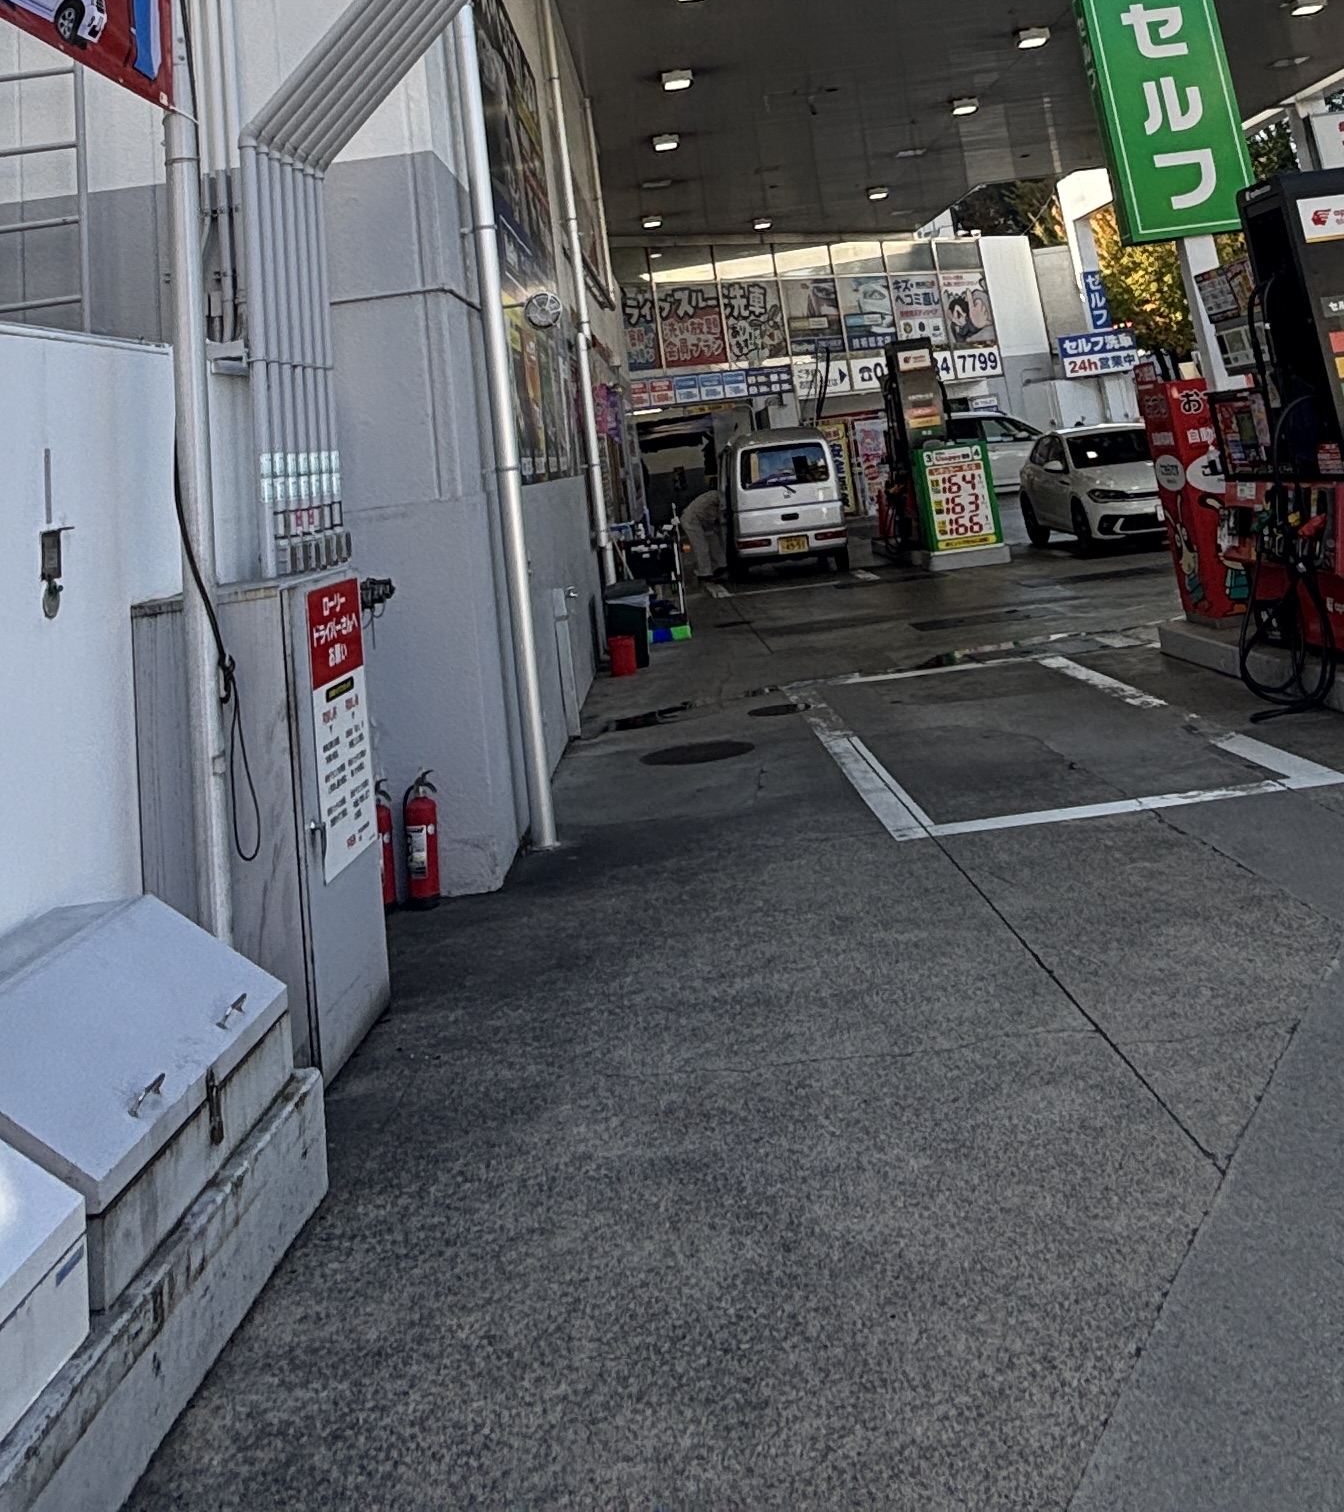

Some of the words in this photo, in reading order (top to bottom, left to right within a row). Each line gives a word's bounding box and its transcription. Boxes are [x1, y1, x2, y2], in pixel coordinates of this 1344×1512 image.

[1120, 4, 1216, 210] セルフ
[624, 283, 767, 326] ライブスルー洗車
[1086, 272, 1107, 325] セルフ
[662, 315, 721, 338] 洗い放題
[664, 338, 724, 361] 会員プラン
[1063, 335, 1134, 355] セルフ洗車
[957, 351, 998, 373] 7799
[1069, 354, 1136, 373] 24h営業中
[925, 453, 932, 463] 3
[974, 449, 980, 458] 4
[941, 473, 976, 495] 164
[945, 493, 980, 516] 163
[949, 514, 984, 536] 166
[323, 593, 346, 616] ローリー
[313, 613, 358, 648] ドライバーさんへ
